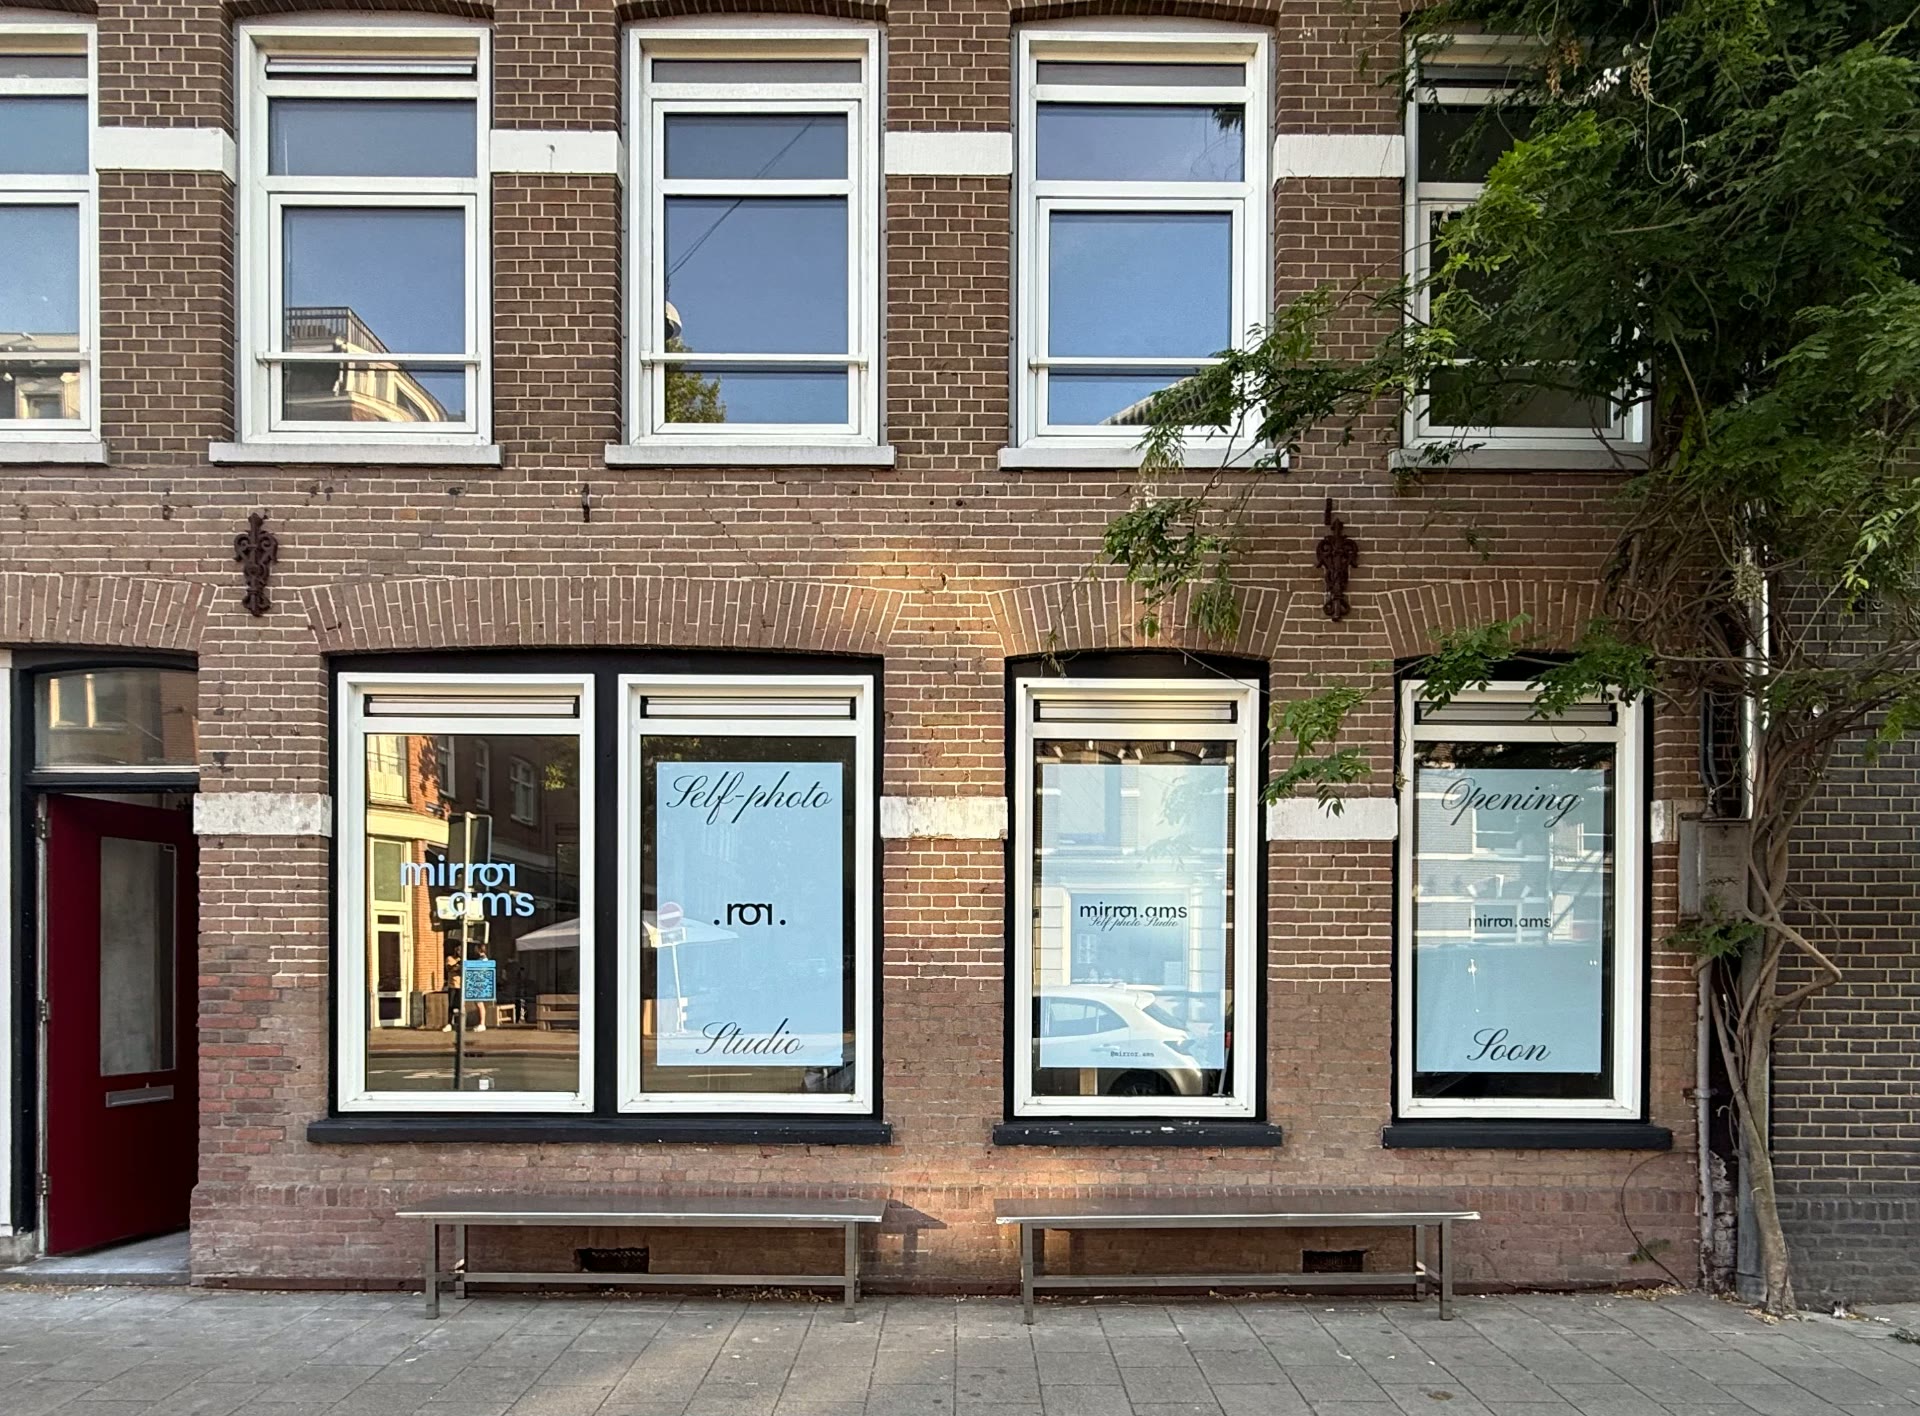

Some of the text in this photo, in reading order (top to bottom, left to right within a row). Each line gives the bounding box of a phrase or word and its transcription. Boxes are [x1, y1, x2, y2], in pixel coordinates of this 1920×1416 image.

[666, 770, 833, 826] Self-photo
[1441, 777, 1583, 829] Opening
[400, 854, 516, 887] mirror
[449, 891, 535, 917] ams
[1080, 901, 1188, 918] mirror.ams
[1089, 915, 1179, 932] Self-photo Studio
[695, 1017, 805, 1055] Studio
[1467, 1028, 1551, 1062] Soon
